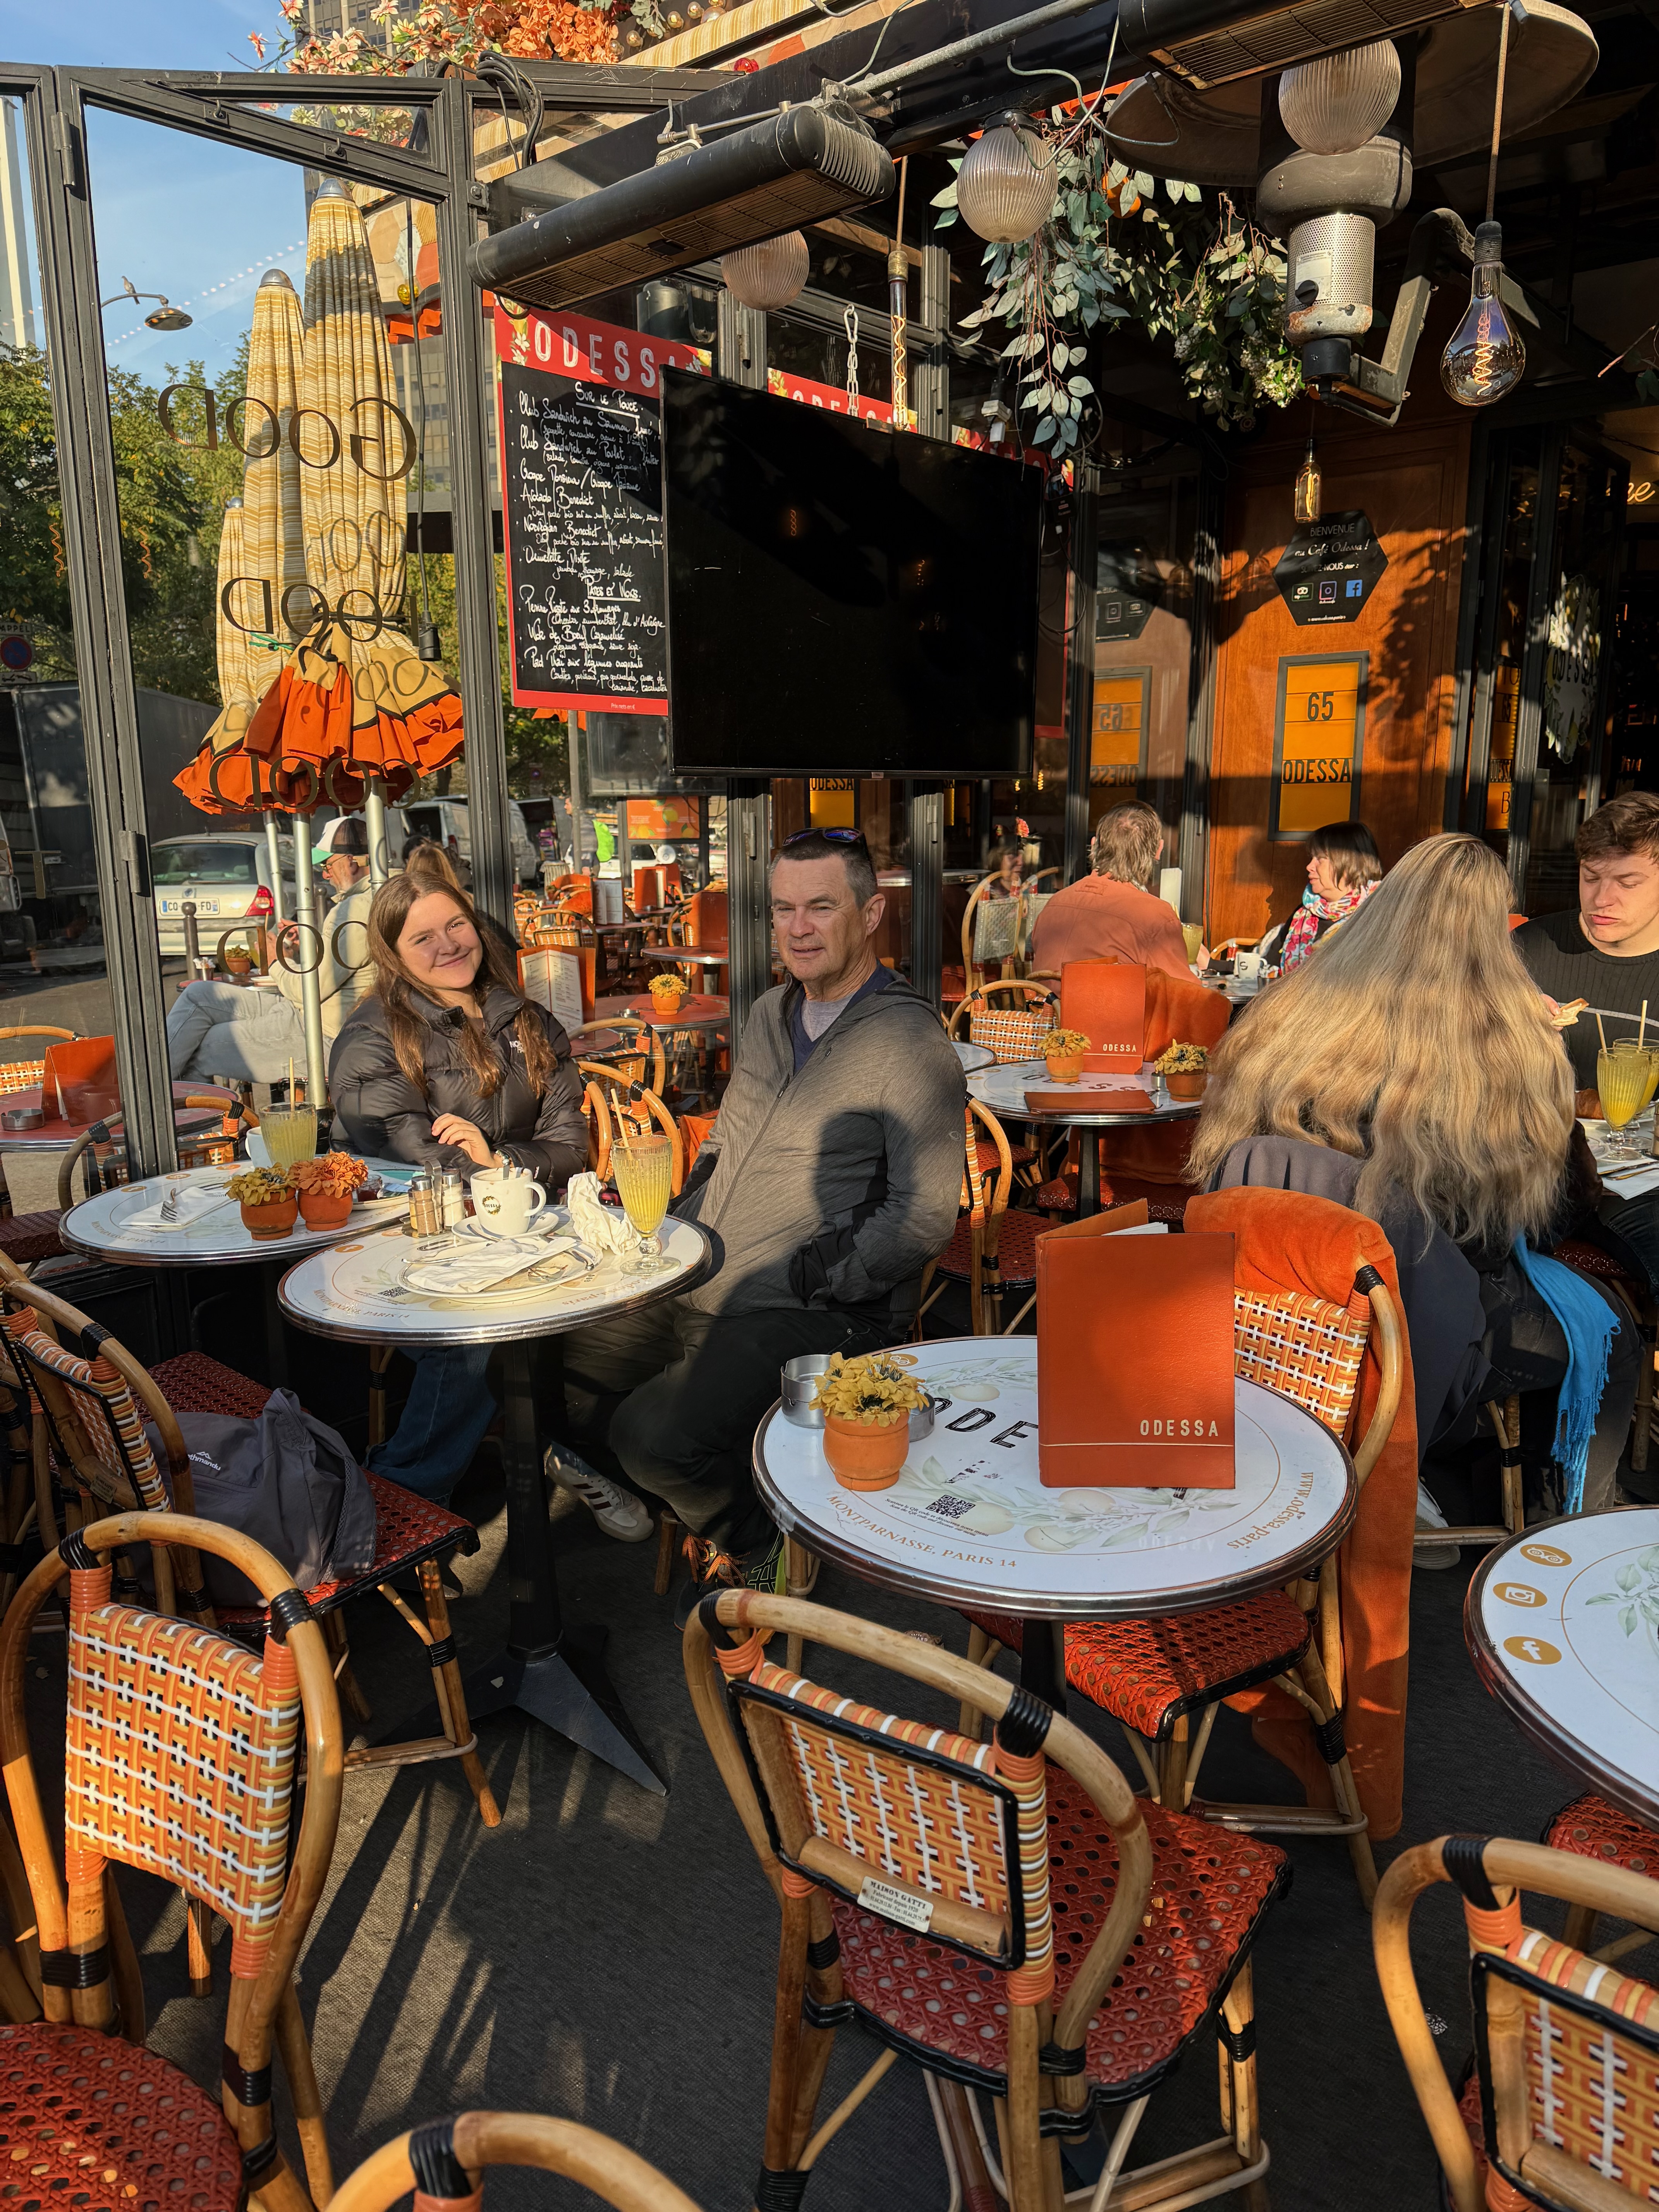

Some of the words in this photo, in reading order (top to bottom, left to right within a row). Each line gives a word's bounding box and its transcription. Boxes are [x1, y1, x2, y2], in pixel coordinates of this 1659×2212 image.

[534, 321, 675, 387] ODESS
[519, 390, 539, 417] Club
[543, 398, 580, 425] Sandwich
[583, 416, 592, 426] au
[520, 424, 538, 450] Club
[544, 434, 582, 454] Sandwich
[586, 447, 597, 455] au
[1310, 523, 1355, 537] BIENVENUE
[1331, 542, 1362, 553] Odessa
[1307, 691, 1334, 721] 65
[1282, 759, 1352, 783] ODESSA
[1103, 1044, 1136, 1053] ODESSA
[1140, 1419, 1218, 1437] ODESSA
[941, 1549, 994, 1565] PARIS
[871, 1881, 900, 1898] MAISON
[901, 1894, 927, 1909] GATTI
